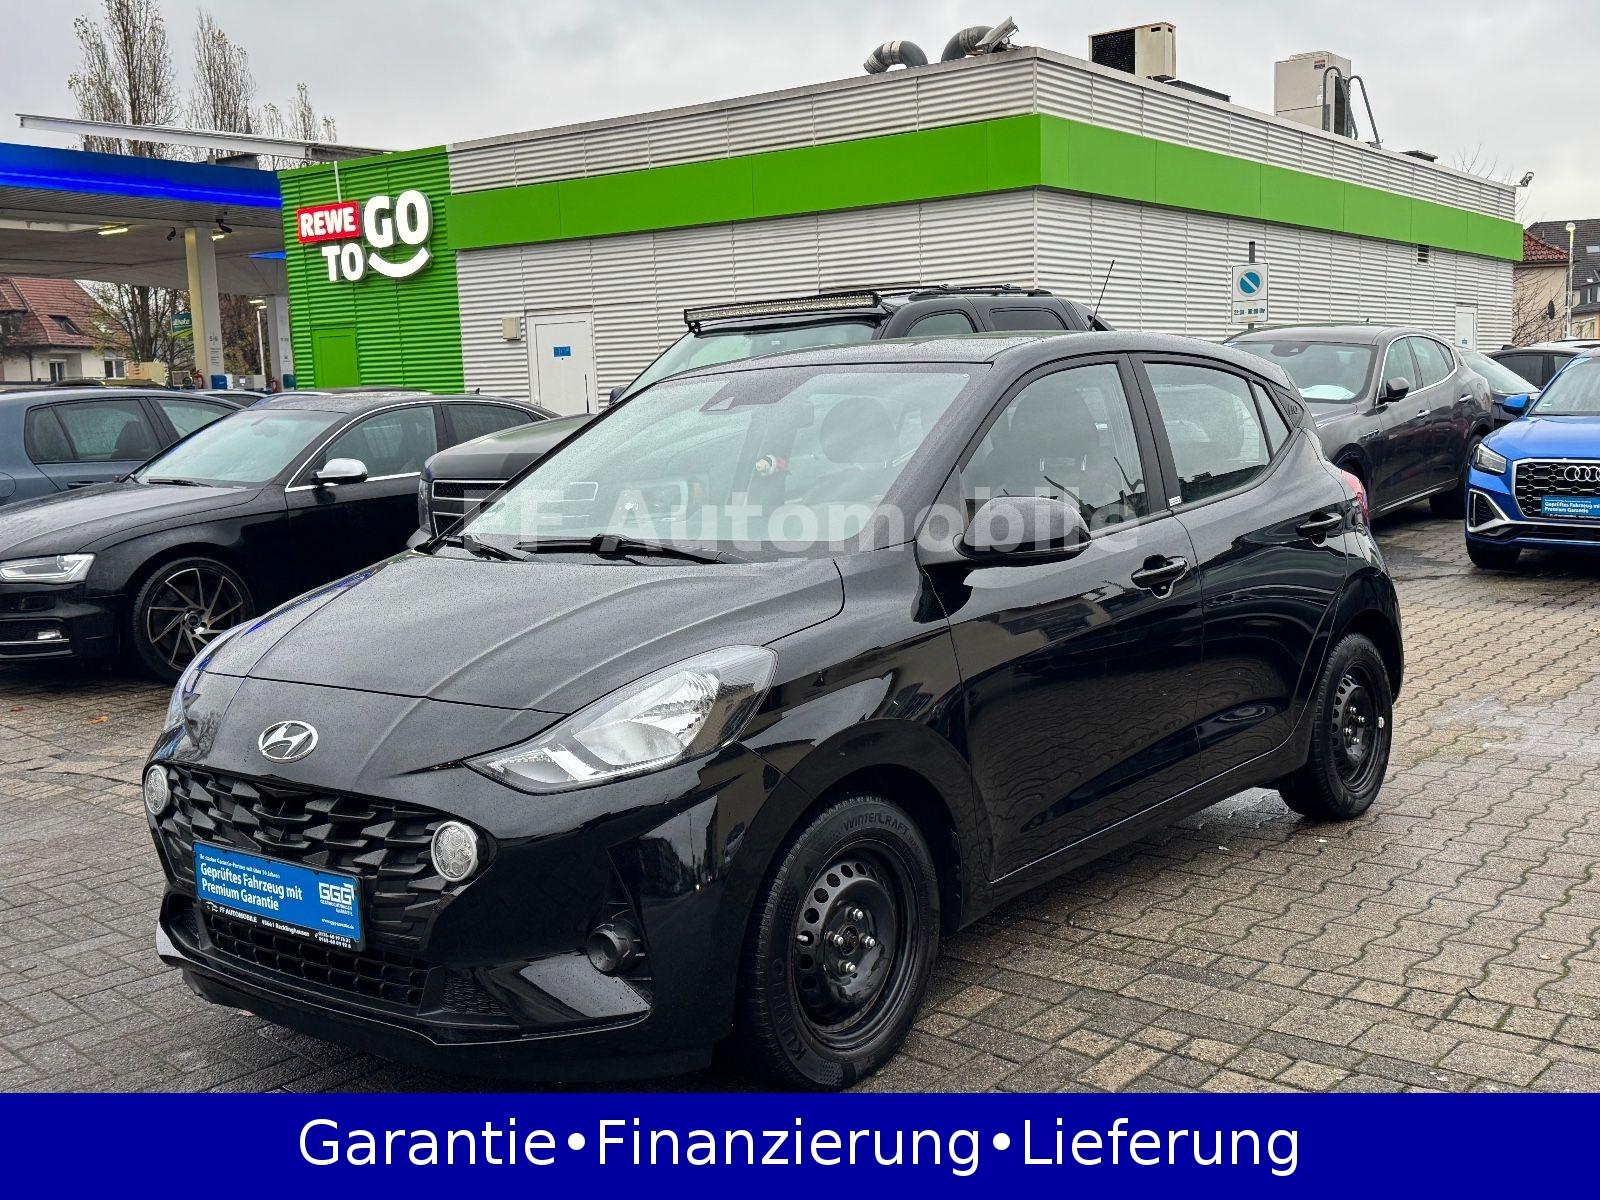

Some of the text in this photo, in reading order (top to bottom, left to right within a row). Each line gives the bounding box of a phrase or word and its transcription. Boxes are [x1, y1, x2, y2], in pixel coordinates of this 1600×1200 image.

[300, 207, 357, 238] REWE
[321, 189, 430, 282] TO GO
[200, 862, 303, 900] Geprüftes Fahrzeug mit
[202, 877, 279, 911] Premium Garantie
[318, 881, 355, 906] GGG
[225, 908, 258, 923] AUTOMOBILE
